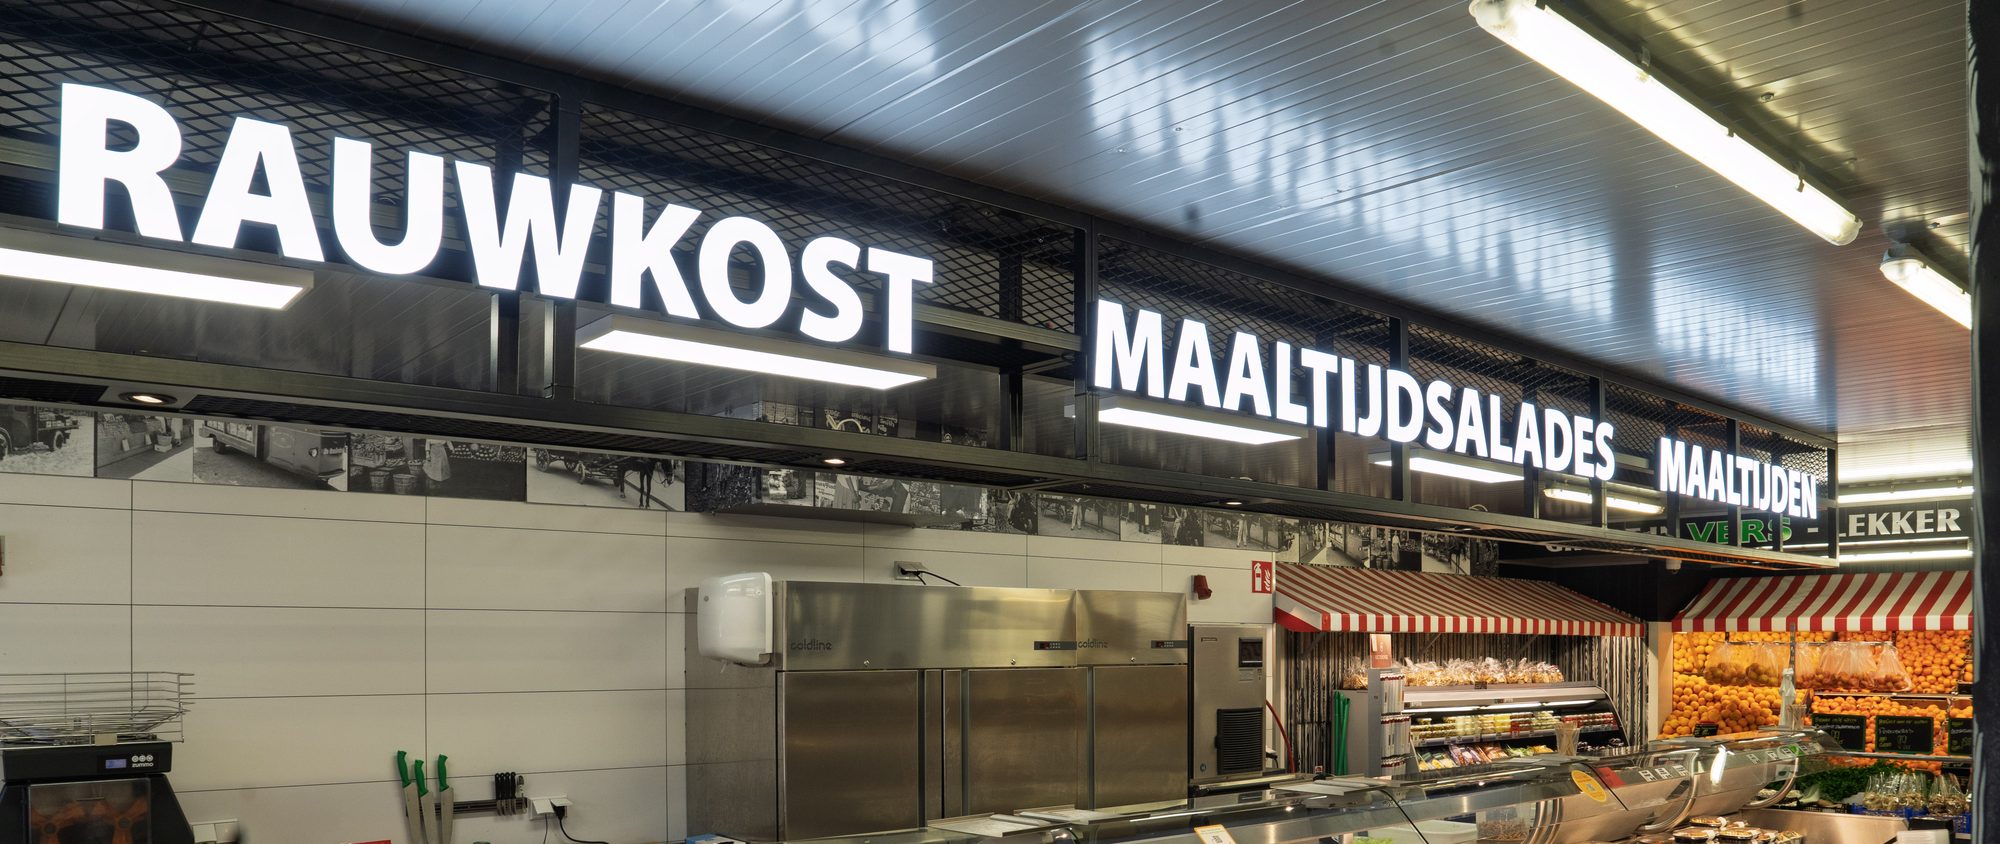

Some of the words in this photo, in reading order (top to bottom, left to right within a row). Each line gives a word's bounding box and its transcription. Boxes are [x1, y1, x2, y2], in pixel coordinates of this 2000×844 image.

[57, 82, 935, 354] RAUWKOST
[1095, 299, 1616, 481] MAALTIJDSALADES
[1657, 437, 1817, 519] MAALTIJDEN
[1838, 508, 1962, 538] EKKER
[790, 639, 833, 651] coldline
